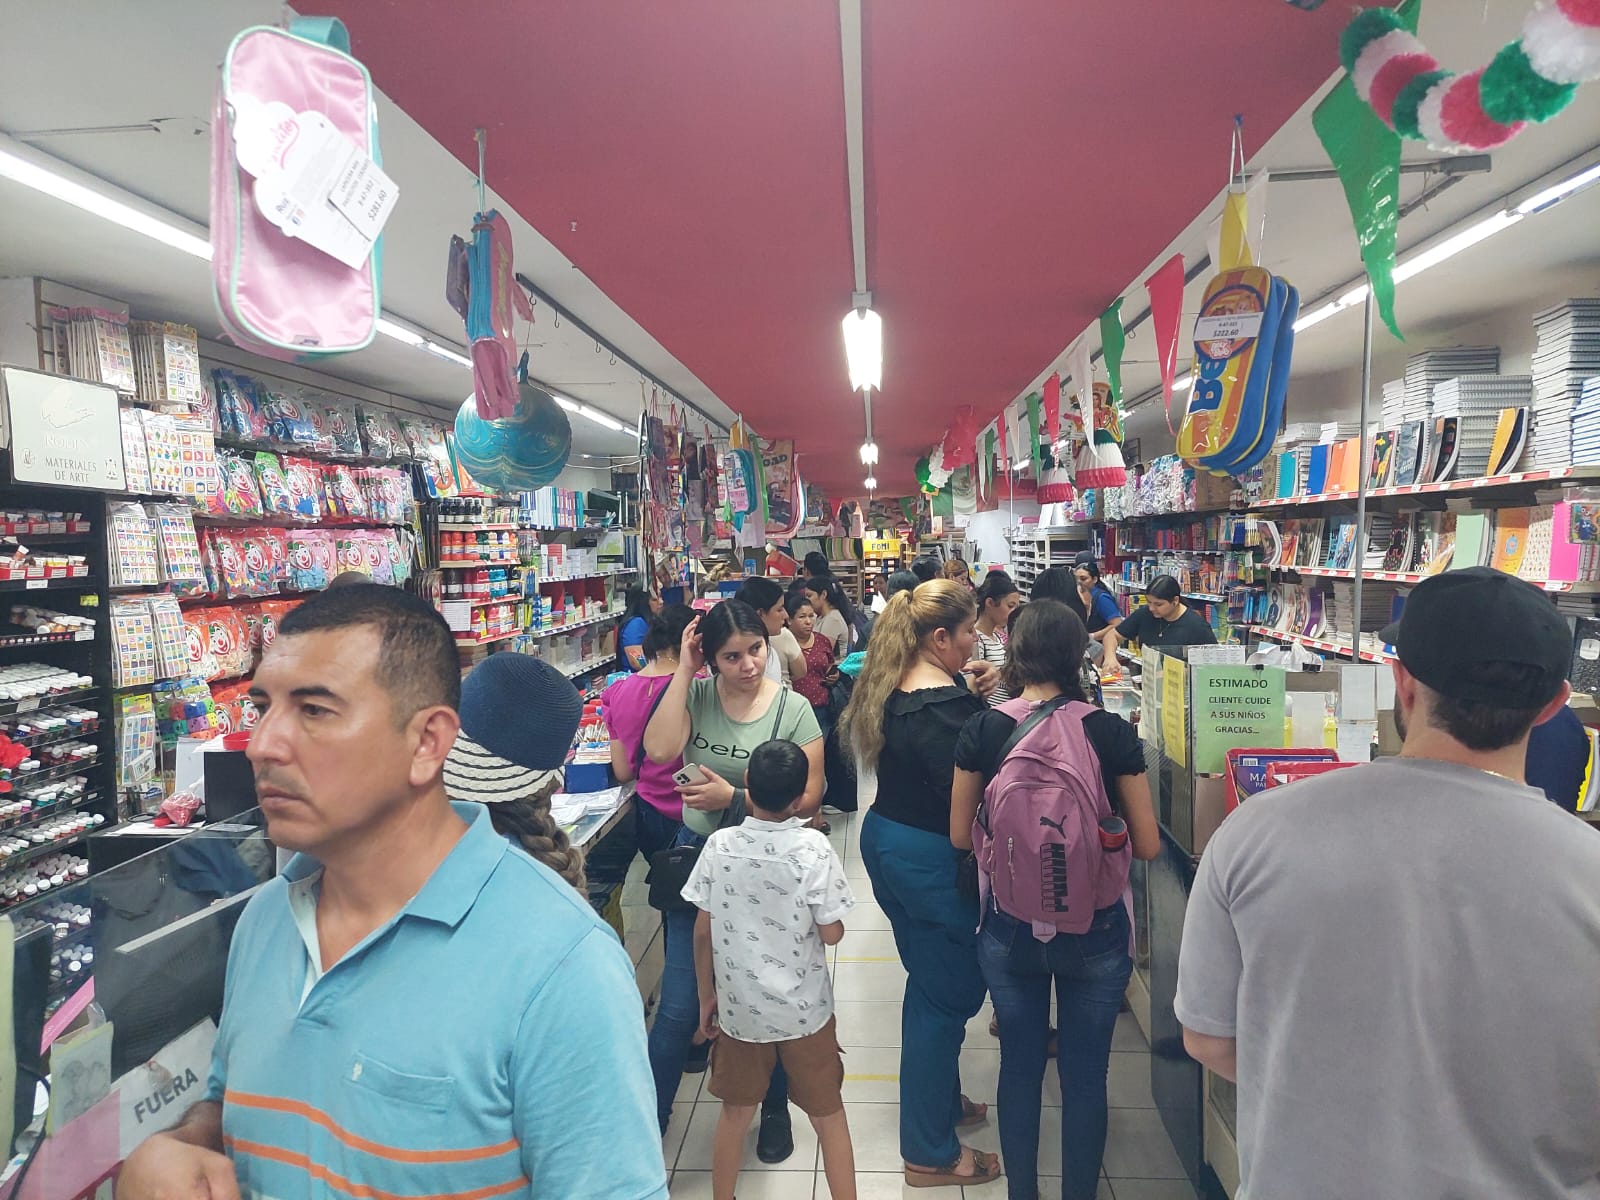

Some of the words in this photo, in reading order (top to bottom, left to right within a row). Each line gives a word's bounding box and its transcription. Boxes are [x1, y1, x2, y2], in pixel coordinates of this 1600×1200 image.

[45, 456, 97, 472] MATERIALES
[54, 470, 65, 480] DE
[69, 472, 89, 482] ARTE
[1209, 678, 1268, 689] ESTIMADO
[1208, 696, 1243, 704] CLIENTE
[1245, 697, 1271, 705] CUIDE
[1219, 711, 1236, 719] SUS
[1237, 710, 1266, 719] NIÑOS
[692, 732, 750, 760] beb
[134, 1068, 199, 1124] FUERA
